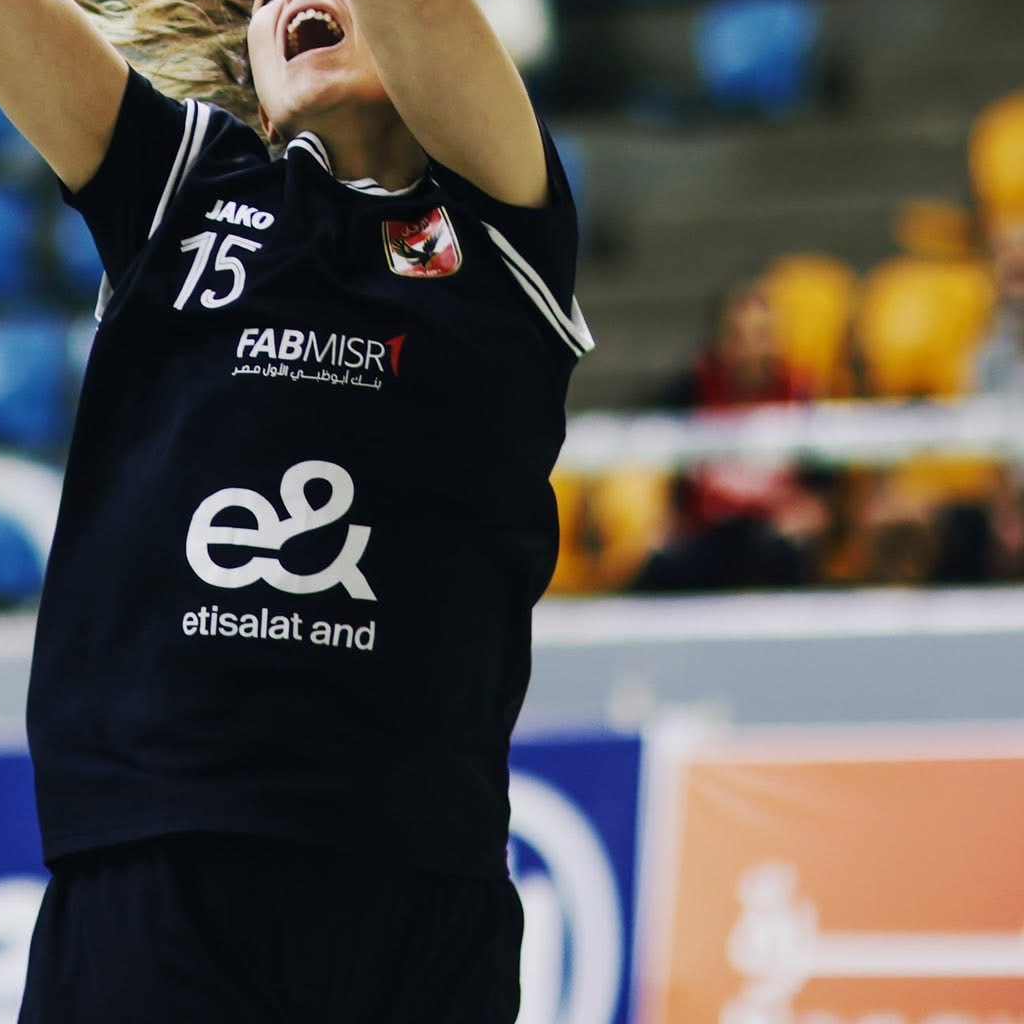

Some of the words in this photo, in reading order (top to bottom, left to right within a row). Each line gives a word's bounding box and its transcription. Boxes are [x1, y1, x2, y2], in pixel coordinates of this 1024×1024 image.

[205, 199, 275, 230] JAKO
[173, 231, 263, 311] 15
[182, 605, 303, 640] etisalat
[310, 621, 376, 651] and
